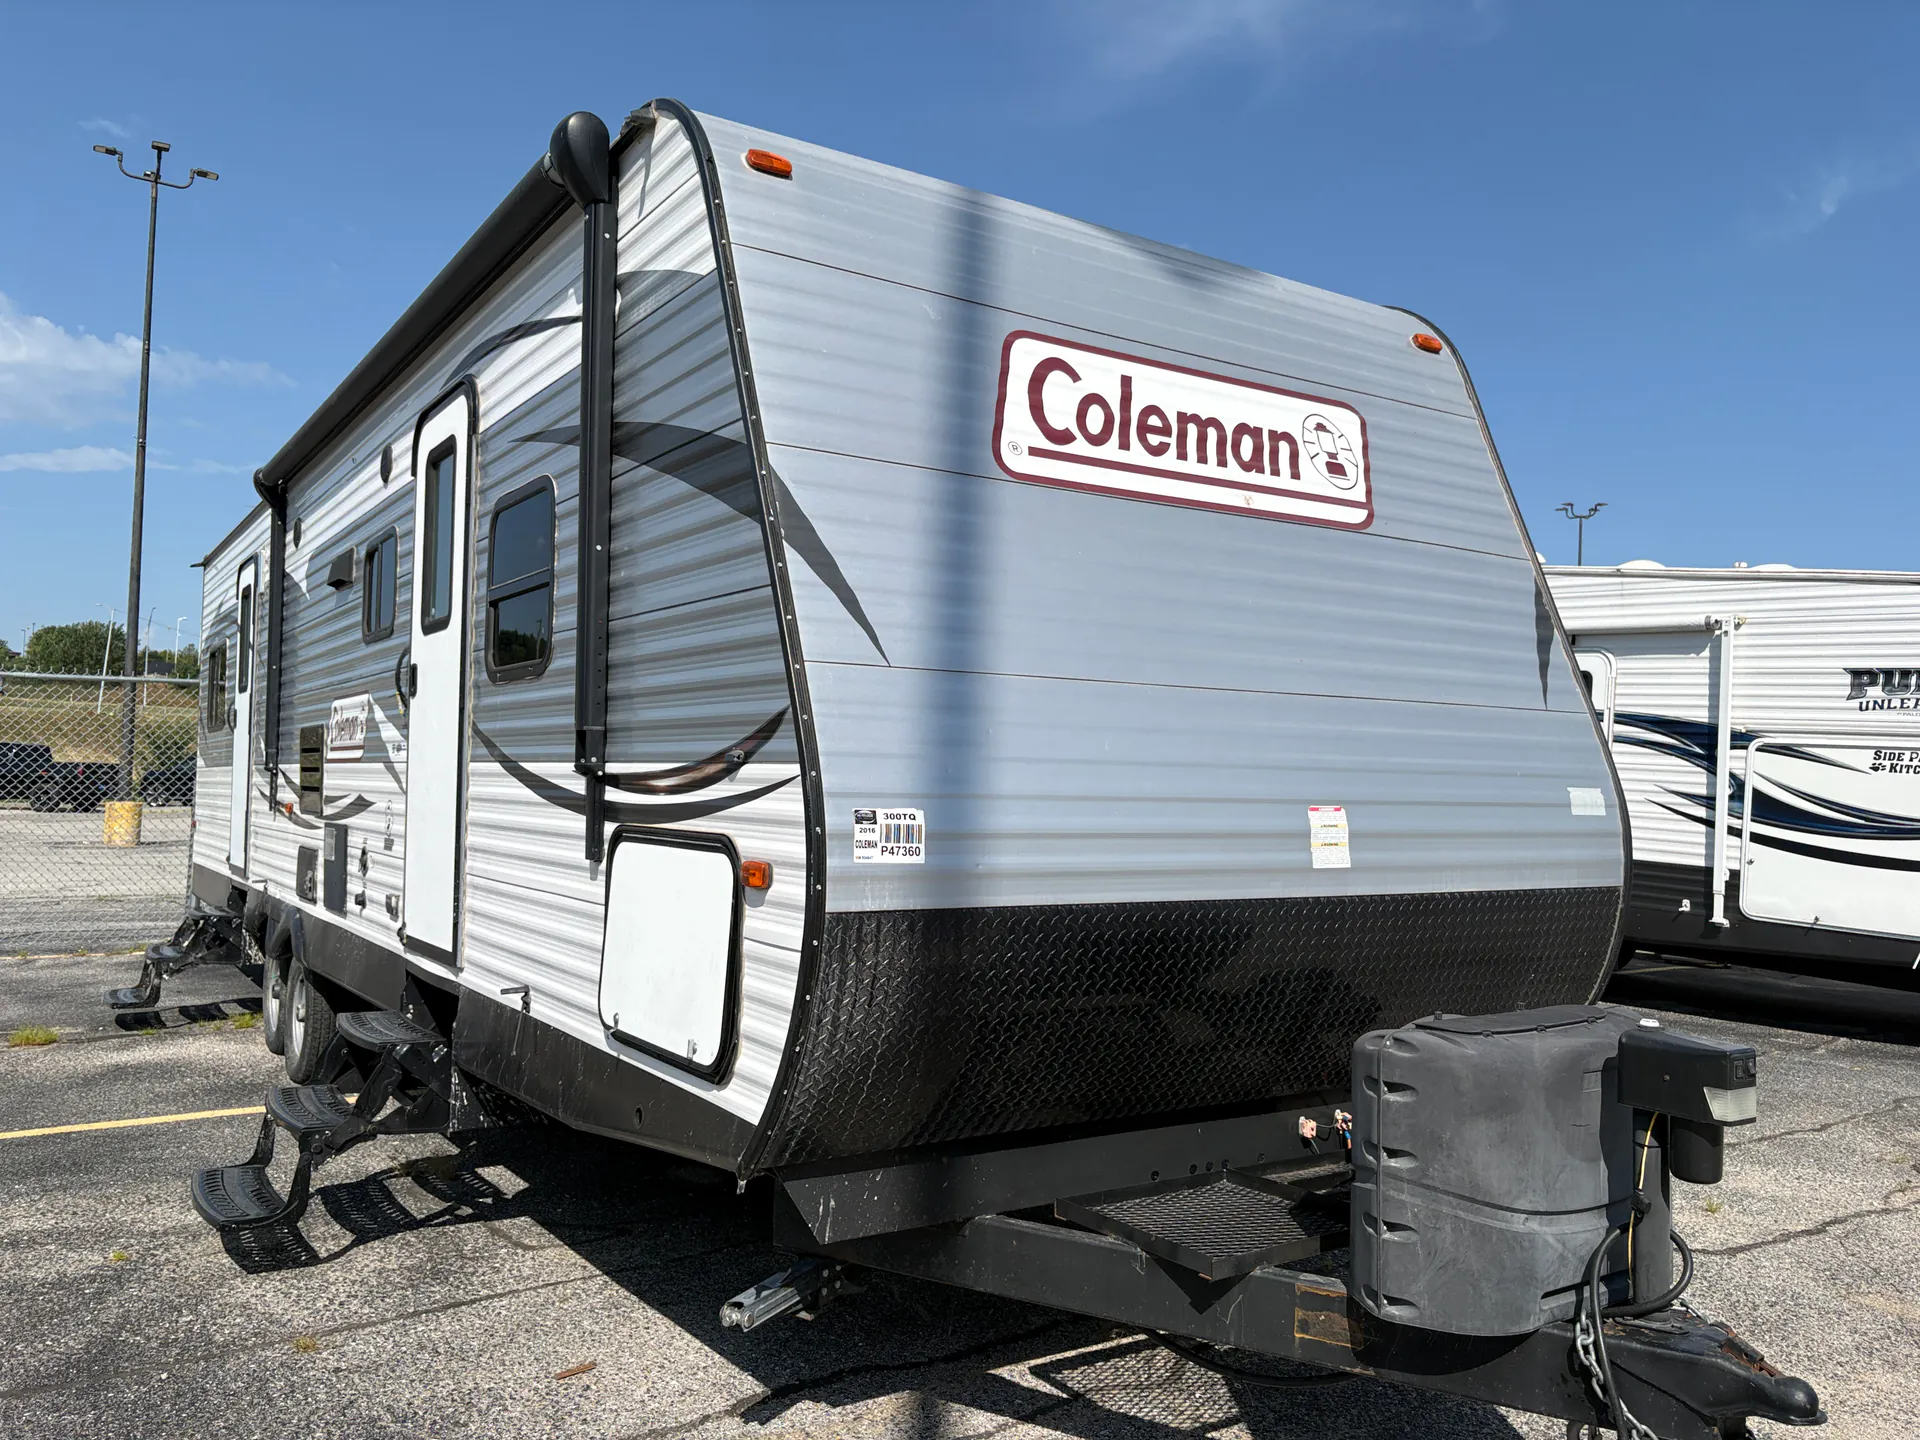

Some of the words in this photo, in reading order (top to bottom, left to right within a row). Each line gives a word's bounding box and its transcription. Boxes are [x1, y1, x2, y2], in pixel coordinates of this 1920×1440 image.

[1027, 356, 1301, 481] Coleman
[1842, 667, 1920, 701] PU
[1873, 750, 1905, 762] SIDE
[1908, 751, 1920, 763] P
[883, 813, 917, 821] 300TQ
[855, 839, 878, 849] COLEMAN
[881, 845, 921, 857] P47360
